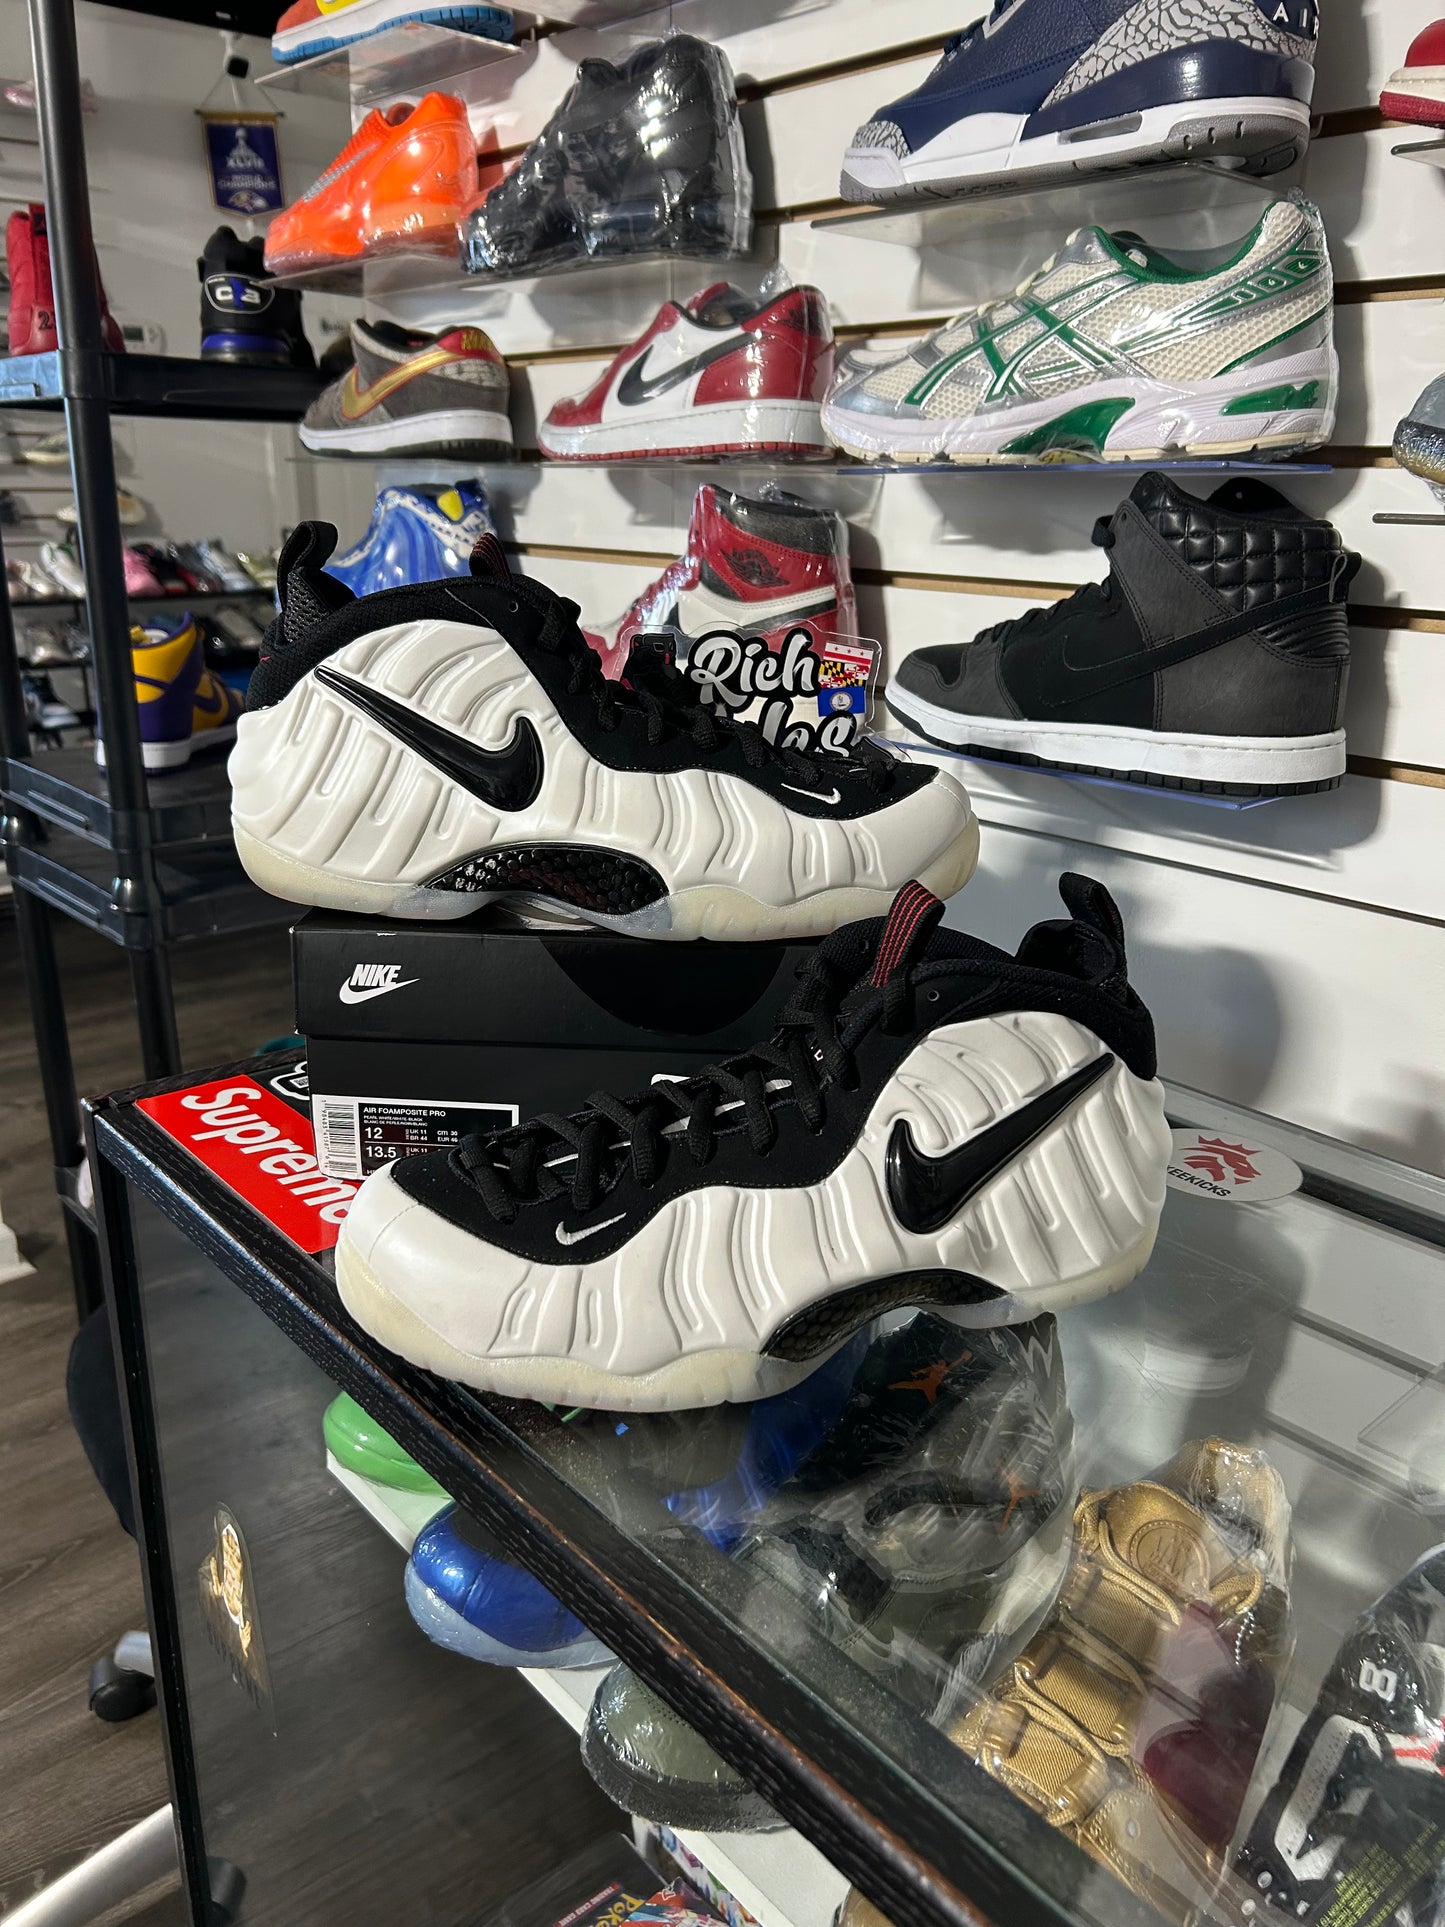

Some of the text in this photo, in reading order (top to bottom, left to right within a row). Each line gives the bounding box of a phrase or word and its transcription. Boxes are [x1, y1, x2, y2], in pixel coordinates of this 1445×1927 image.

[688, 631, 817, 709] Rich
[350, 964, 402, 987] NIKE
[378, 1108, 428, 1116] FOAMPOSITE
[364, 1127, 382, 1140] 12
[366, 1146, 396, 1158] 13.5
